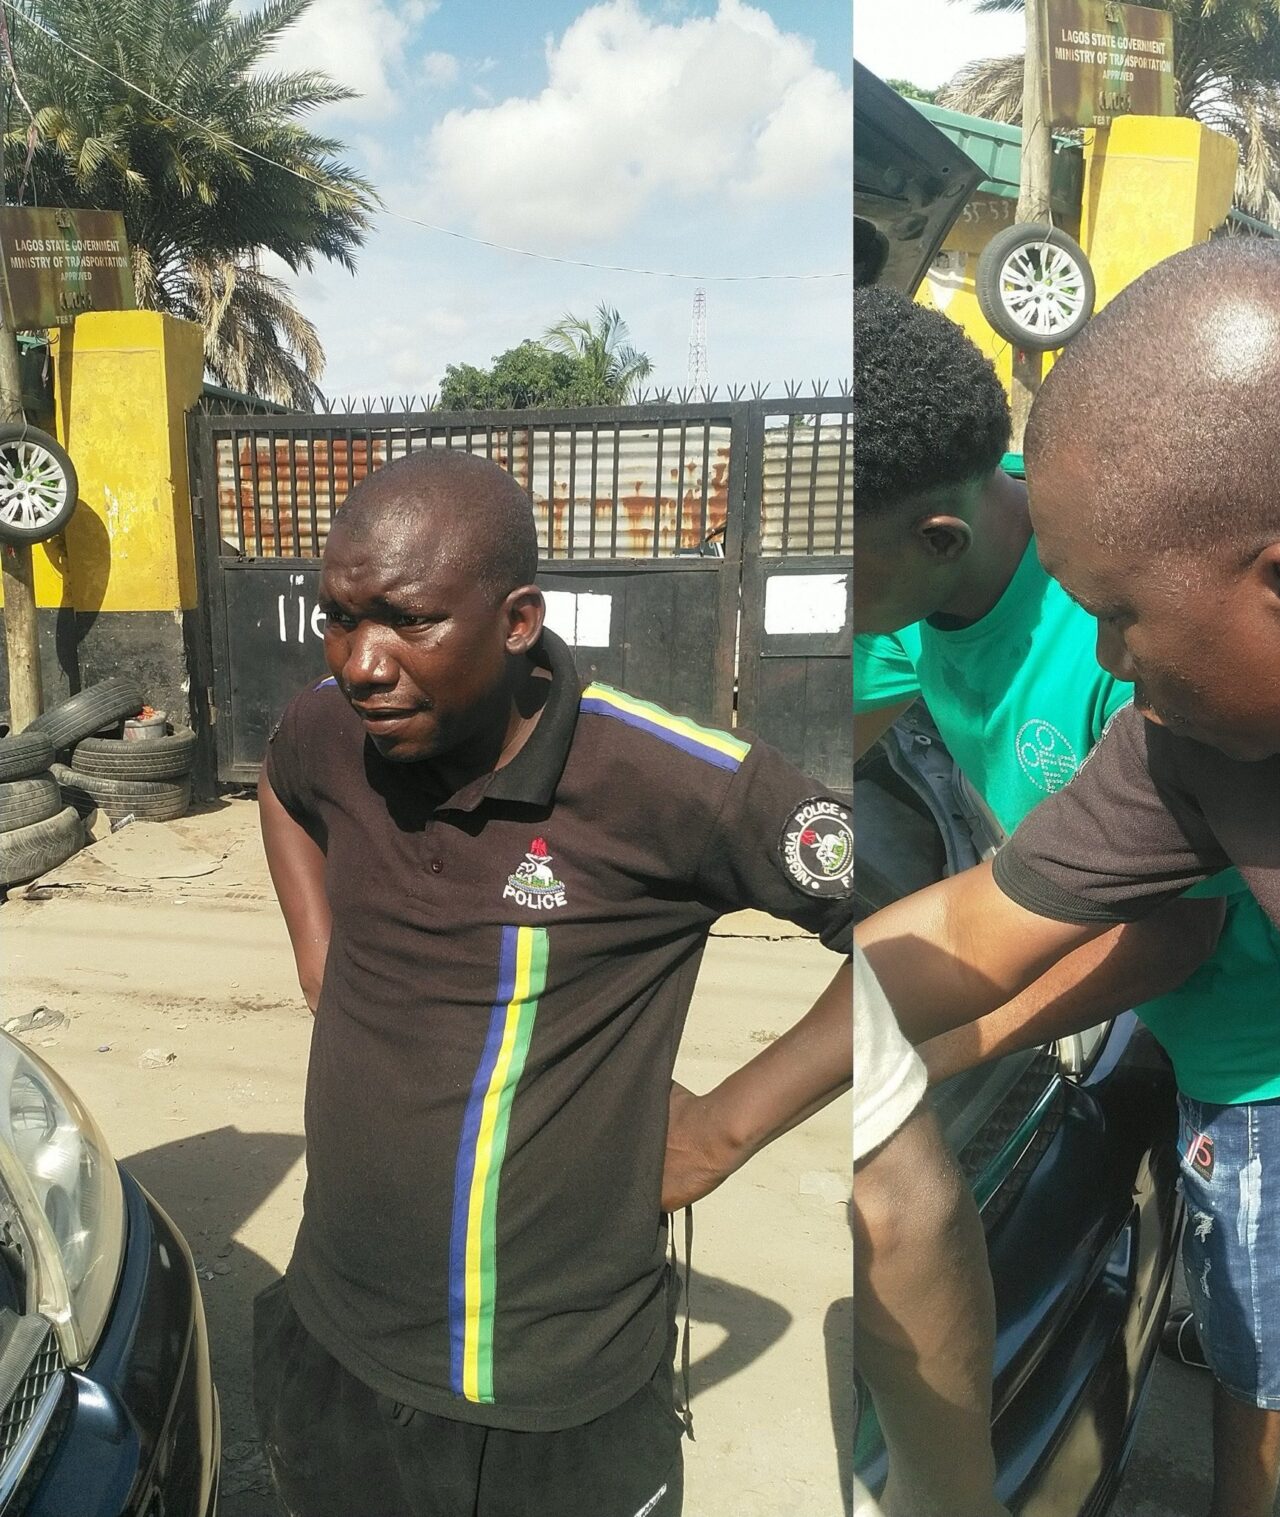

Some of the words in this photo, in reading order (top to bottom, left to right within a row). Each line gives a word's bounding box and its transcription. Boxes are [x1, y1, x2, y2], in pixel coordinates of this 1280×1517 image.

[1062, 29, 1090, 45] LAGOS
[1092, 34, 1116, 48] STATE
[1117, 36, 1166, 55] GOVERNMENT
[1055, 47, 1095, 63] MINISTRY
[1097, 51, 1107, 65] OF
[1109, 53, 1171, 73] TRANSPORTATION
[1093, 115, 1111, 126] TEST
[15, 239, 45, 252] LAGOS
[45, 239, 71, 252] STATE
[71, 239, 120, 252] GOVERNMENT
[10, 256, 51, 269] MINISTRY
[53, 256, 64, 268] OF
[66, 256, 128, 268] TRANSPORTATION
[56, 315, 74, 325] TEST
[795, 801, 840, 826] POLICE
[784, 831, 812, 886] NIGERIA
[502, 884, 568, 910] POLICE
